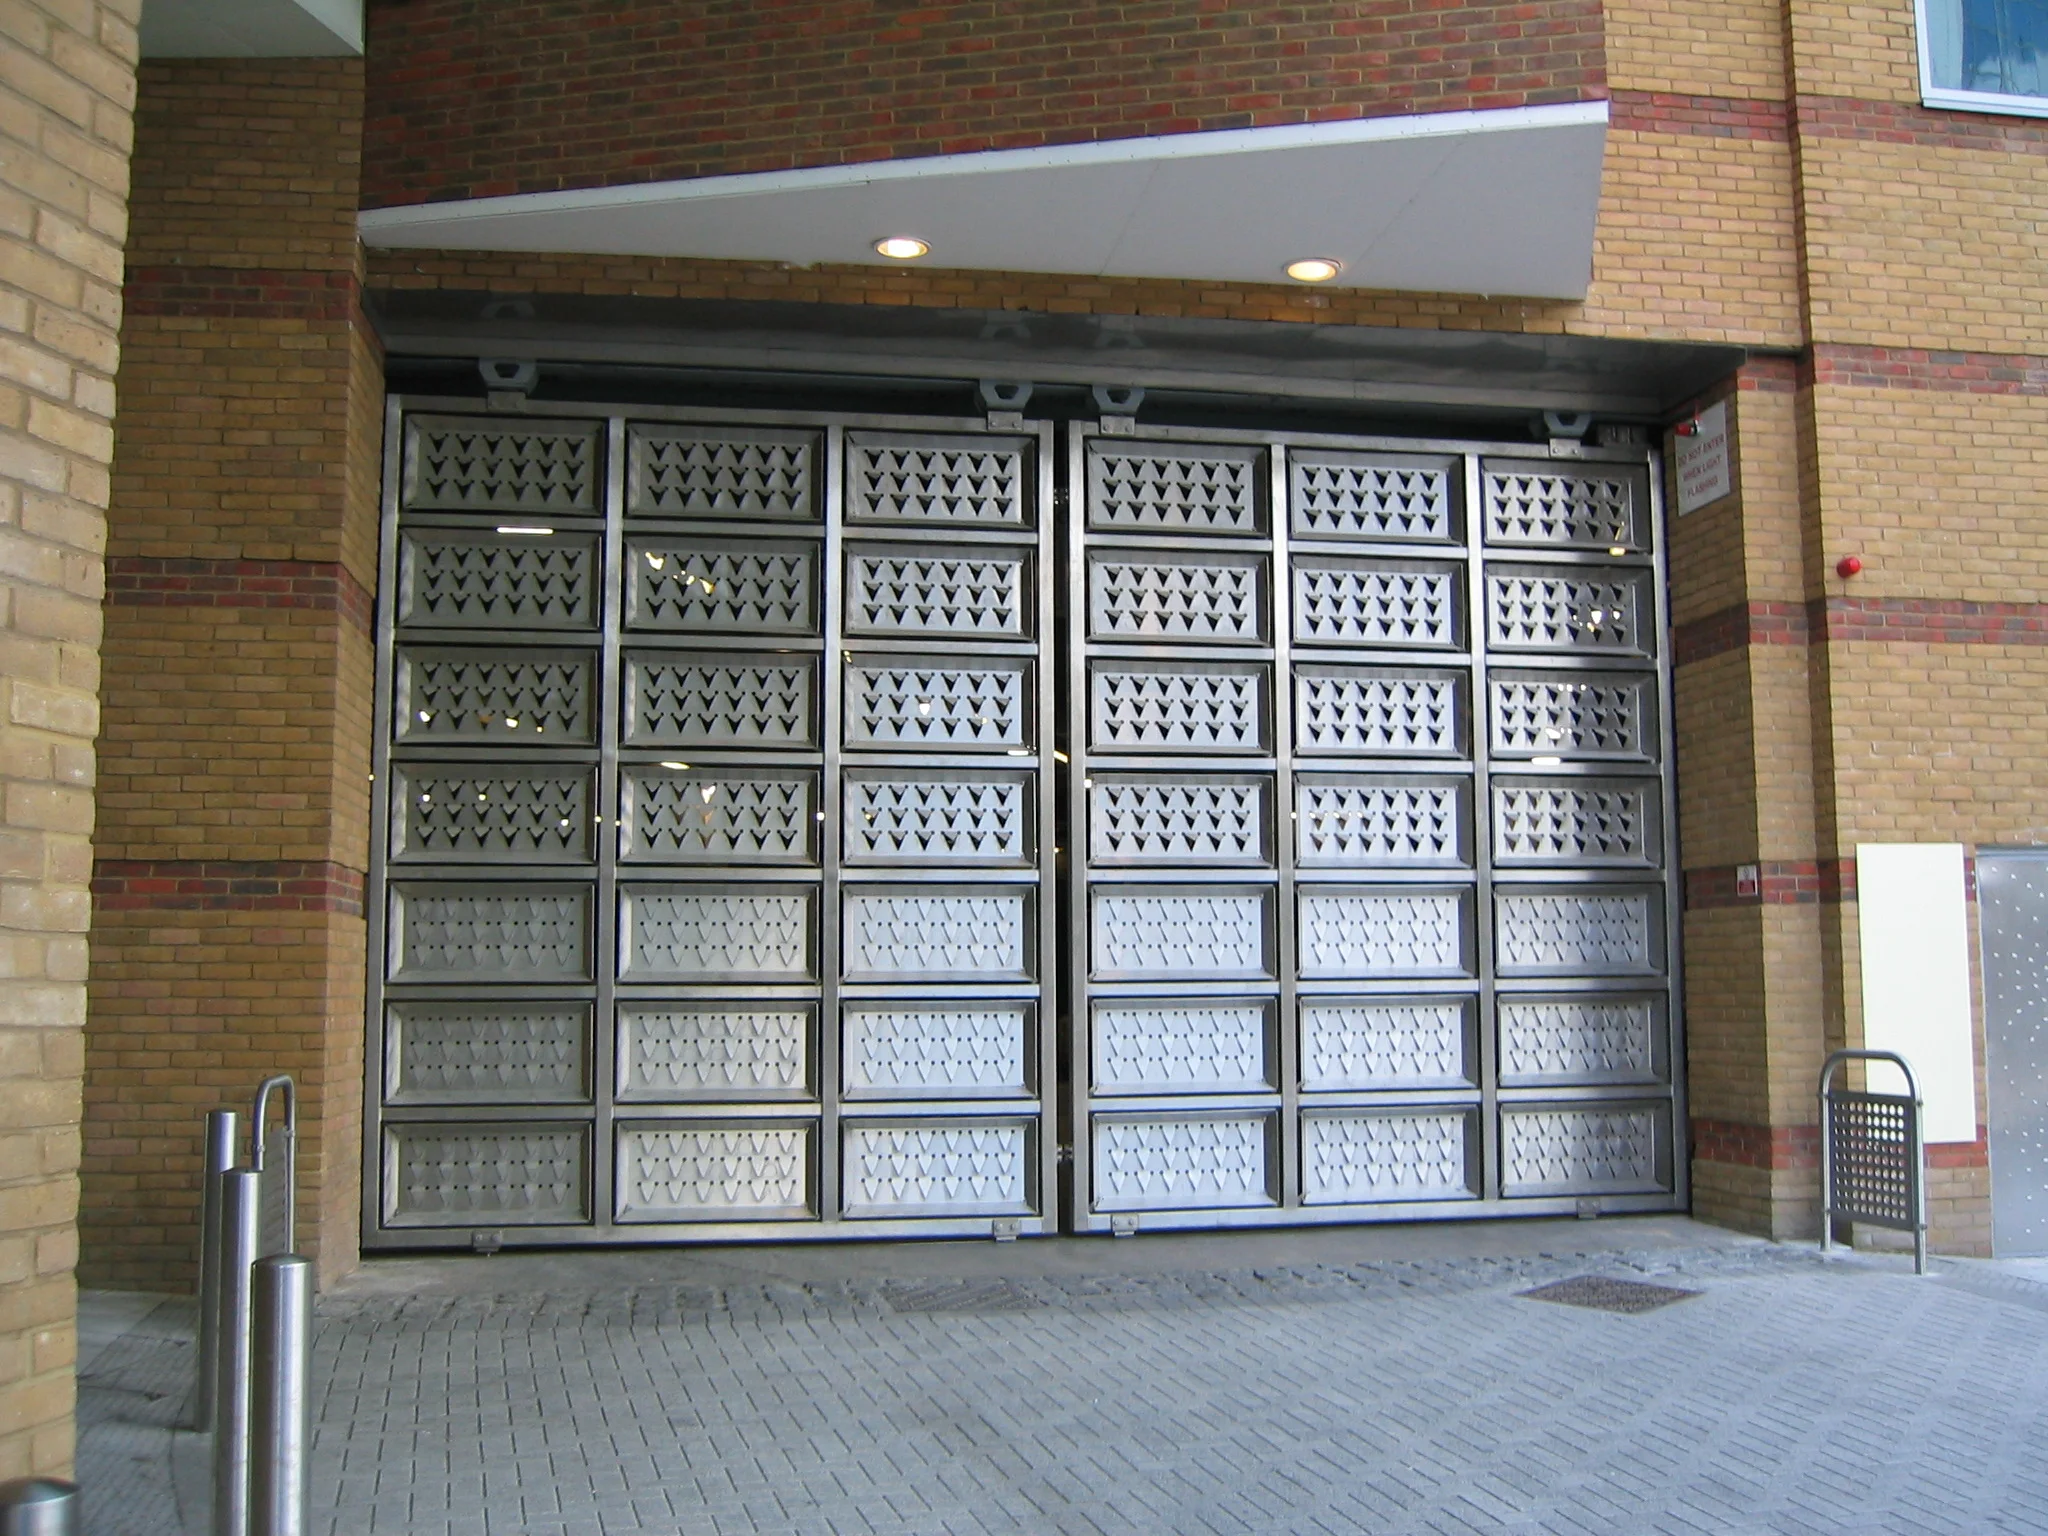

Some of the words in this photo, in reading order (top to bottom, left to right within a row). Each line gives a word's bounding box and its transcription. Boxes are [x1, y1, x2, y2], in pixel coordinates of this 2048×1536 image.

[1688, 446, 1700, 461] NOT
[1703, 434, 1724, 453] ENTER
[1683, 466, 1700, 481] WHEN
[1702, 454, 1721, 472] LIGHT
[1687, 475, 1718, 498] FLASHING
